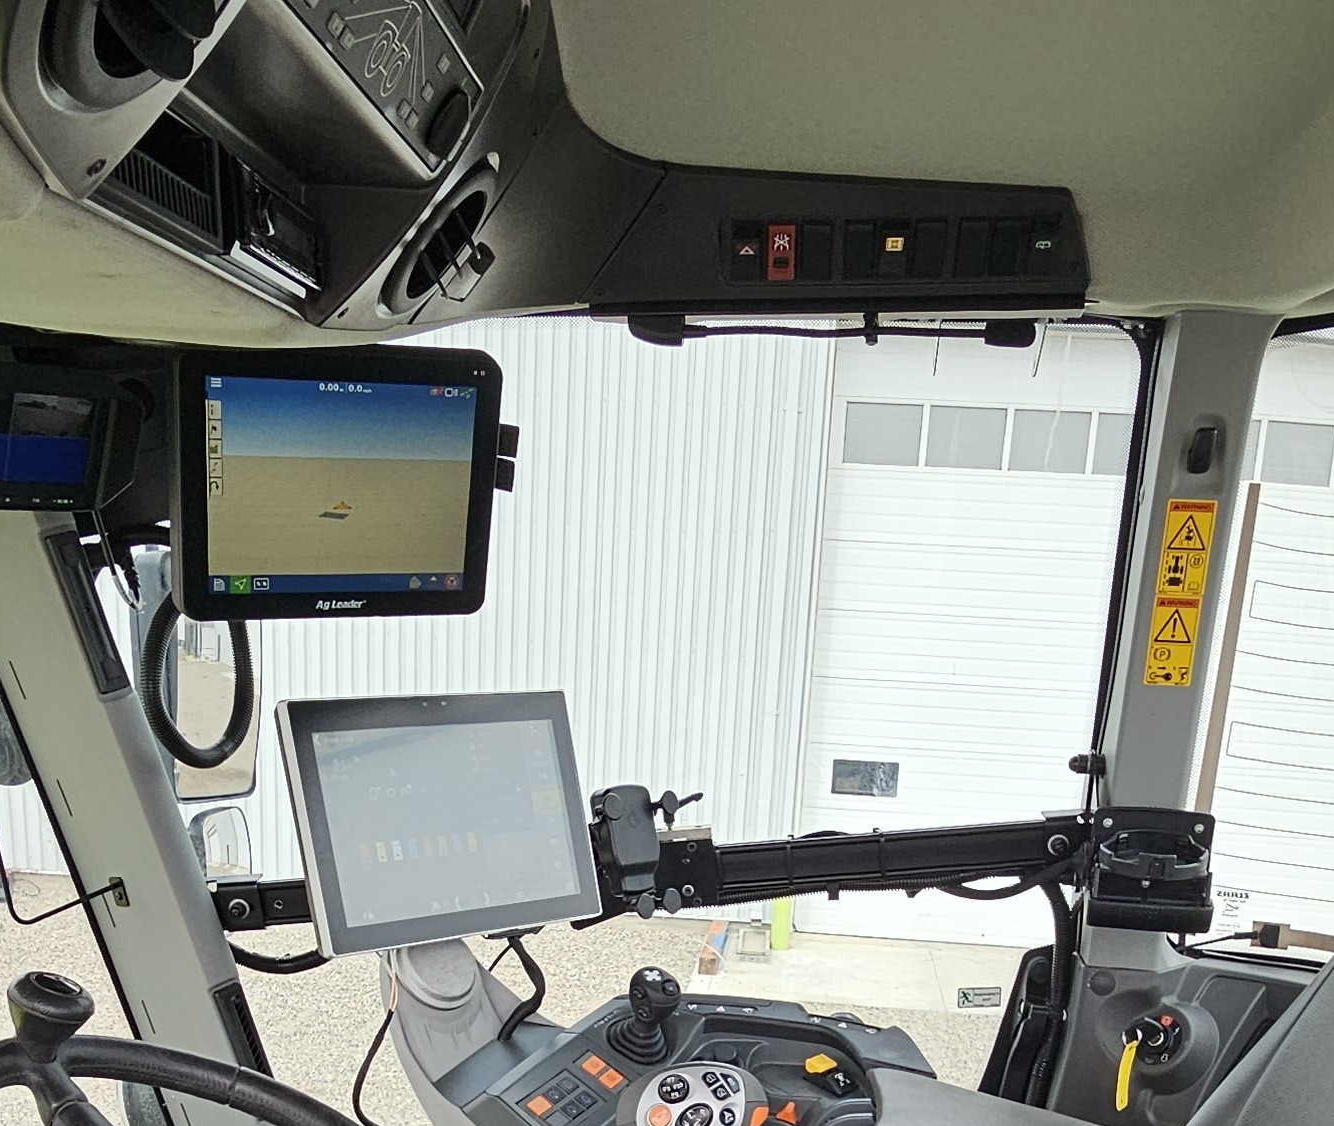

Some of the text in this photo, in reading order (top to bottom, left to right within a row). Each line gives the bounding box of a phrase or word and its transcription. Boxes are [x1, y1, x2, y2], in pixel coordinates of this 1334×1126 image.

[319, 382, 339, 392] 0.00
[348, 384, 363, 393] 0.0
[315, 599, 363, 611] Ag Leader
